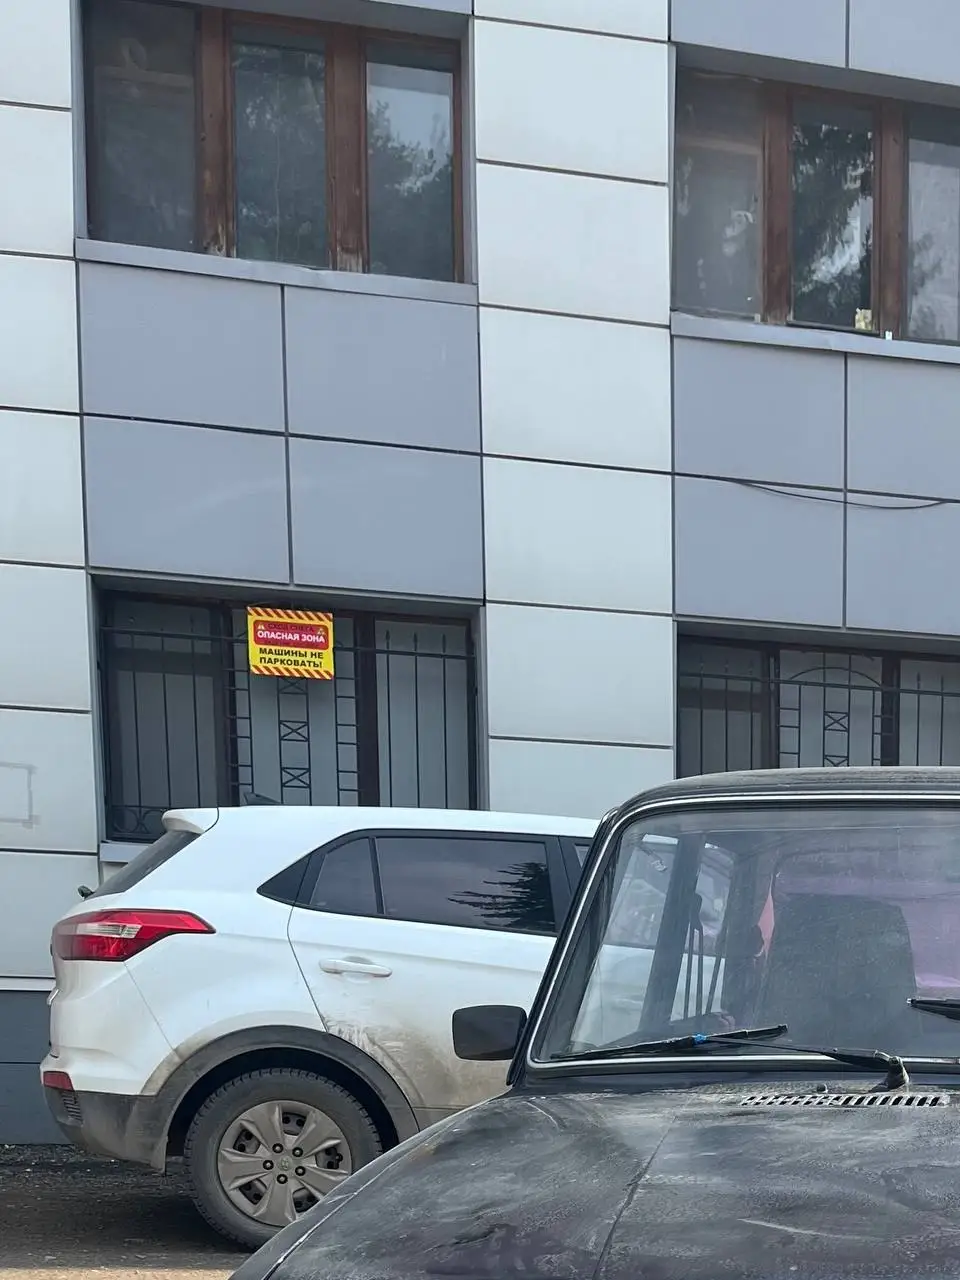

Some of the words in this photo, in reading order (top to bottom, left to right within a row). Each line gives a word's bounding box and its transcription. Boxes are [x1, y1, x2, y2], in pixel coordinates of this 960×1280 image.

[257, 630, 300, 641] ОПАСНАЯ
[301, 633, 325, 643] ЗОНА
[259, 647, 307, 657] МАШИНЫ
[310, 651, 323, 659] НЕ
[259, 657, 322, 668] ПАРКОВАТЬ!
